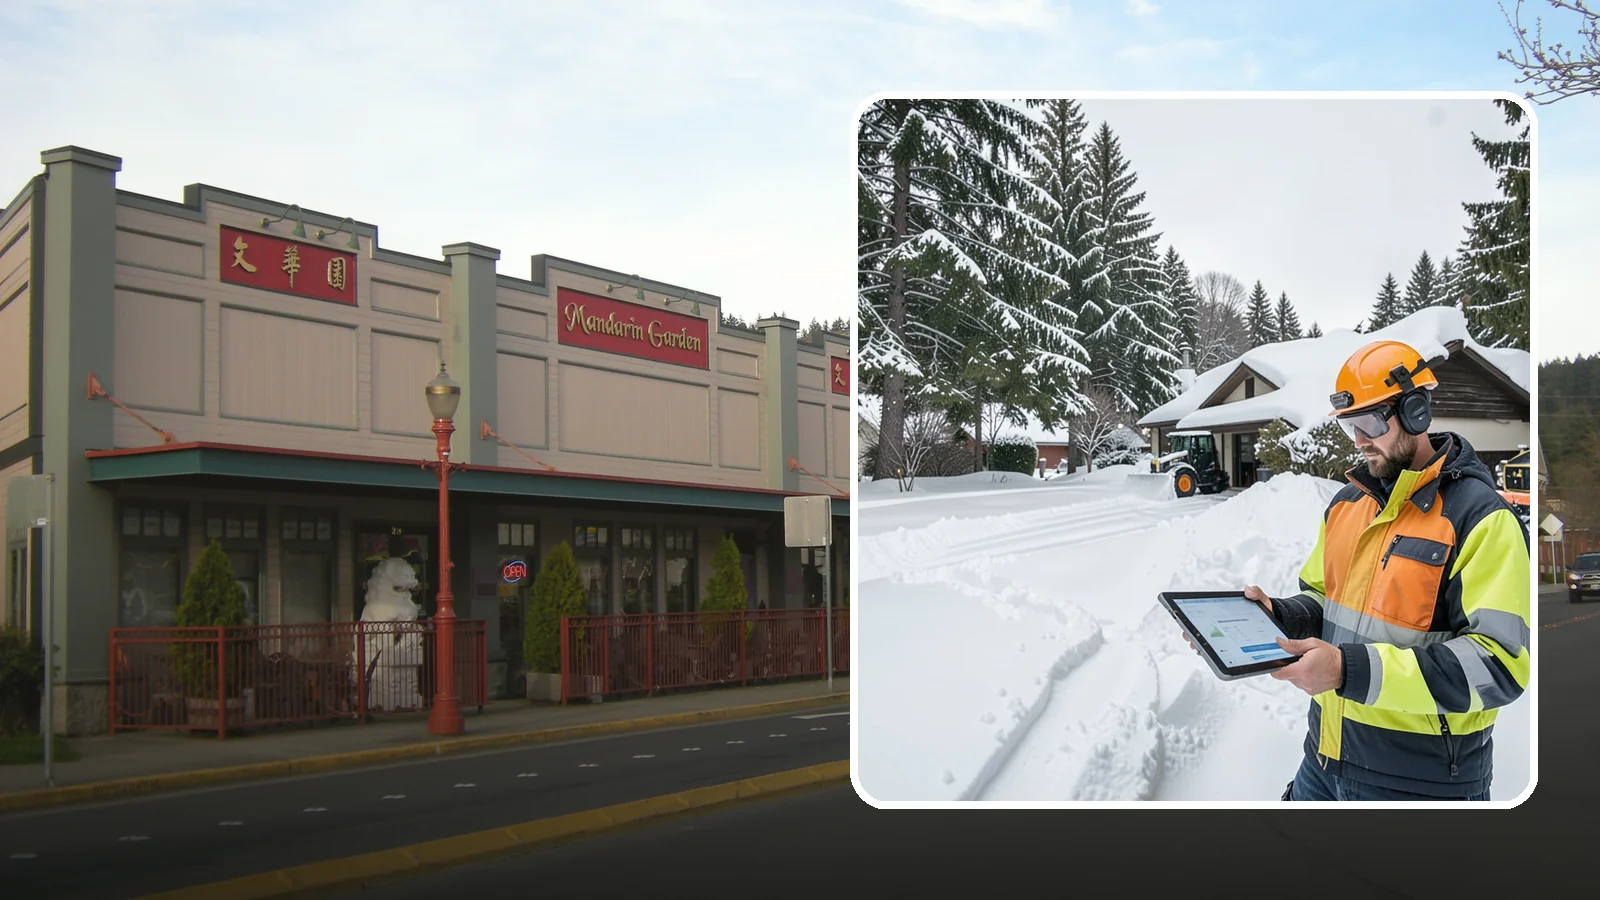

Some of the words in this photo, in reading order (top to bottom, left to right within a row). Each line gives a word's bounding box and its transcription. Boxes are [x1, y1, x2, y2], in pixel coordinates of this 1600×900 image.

[231, 236, 345, 290] 文華園
[564, 302, 644, 340] Mandarin
[648, 320, 702, 352] Garden
[503, 565, 527, 578] OPEN
